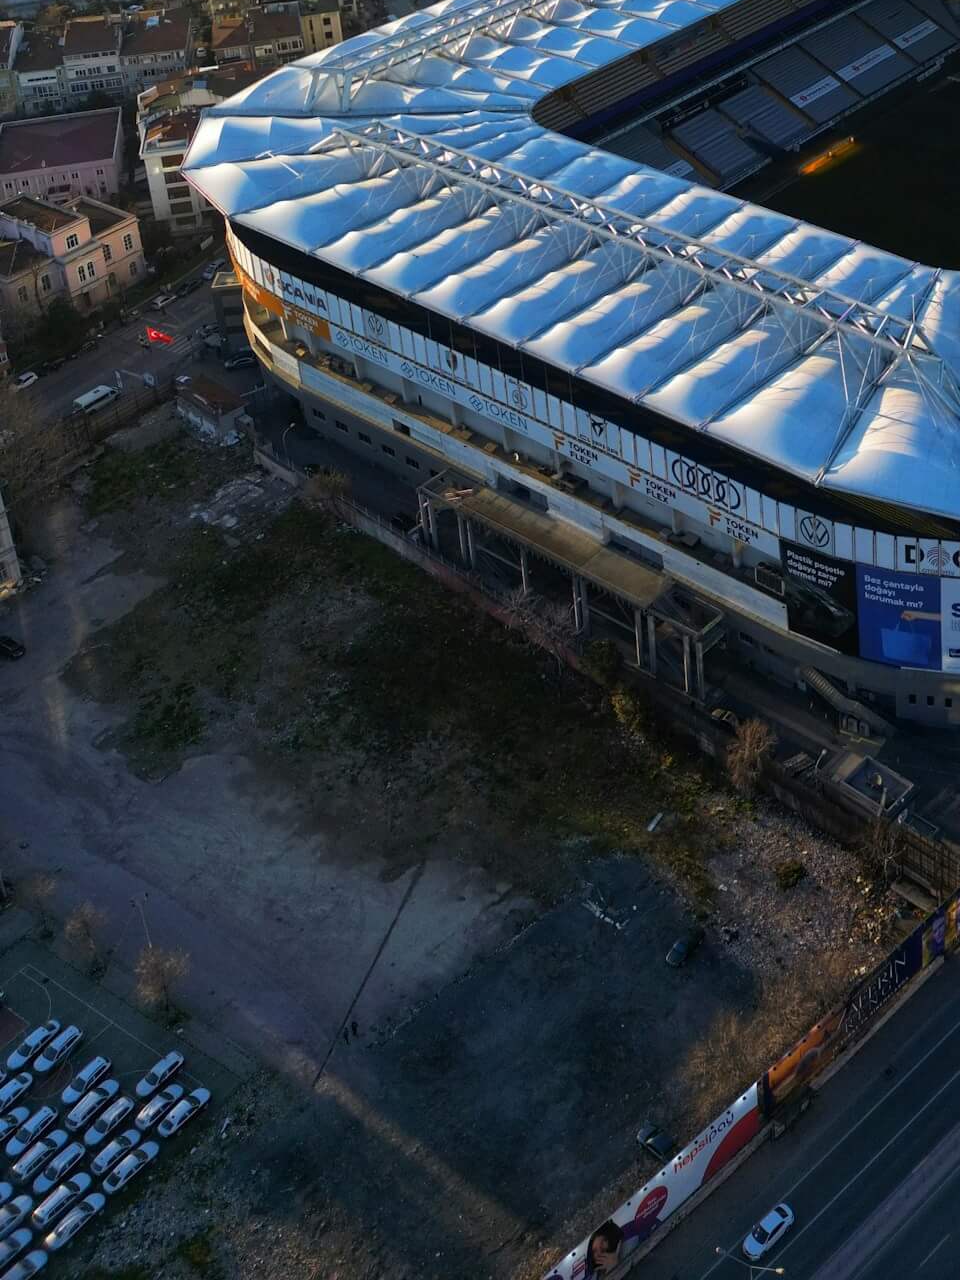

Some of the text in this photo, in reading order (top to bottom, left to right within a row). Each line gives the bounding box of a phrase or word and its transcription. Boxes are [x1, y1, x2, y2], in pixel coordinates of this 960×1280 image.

[350, 338, 389, 363] TOKEN
[414, 367, 456, 396] TOKEN
[484, 401, 528, 430] TOKEN
[568, 441, 598, 461] TOKEN
[570, 451, 592, 466] FLEX
[645, 478, 676, 499] TOKEN
[646, 487, 669, 504] FLEX
[726, 518, 758, 539] TOKEN
[727, 527, 750, 544] FLEX
[786, 550, 814, 565] Plastik
[817, 570, 837, 583] zarar
[864, 575, 924, 593] Bez çantayla
[865, 592, 904, 606] korumak
[674, 1113, 735, 1174] hepsipay
